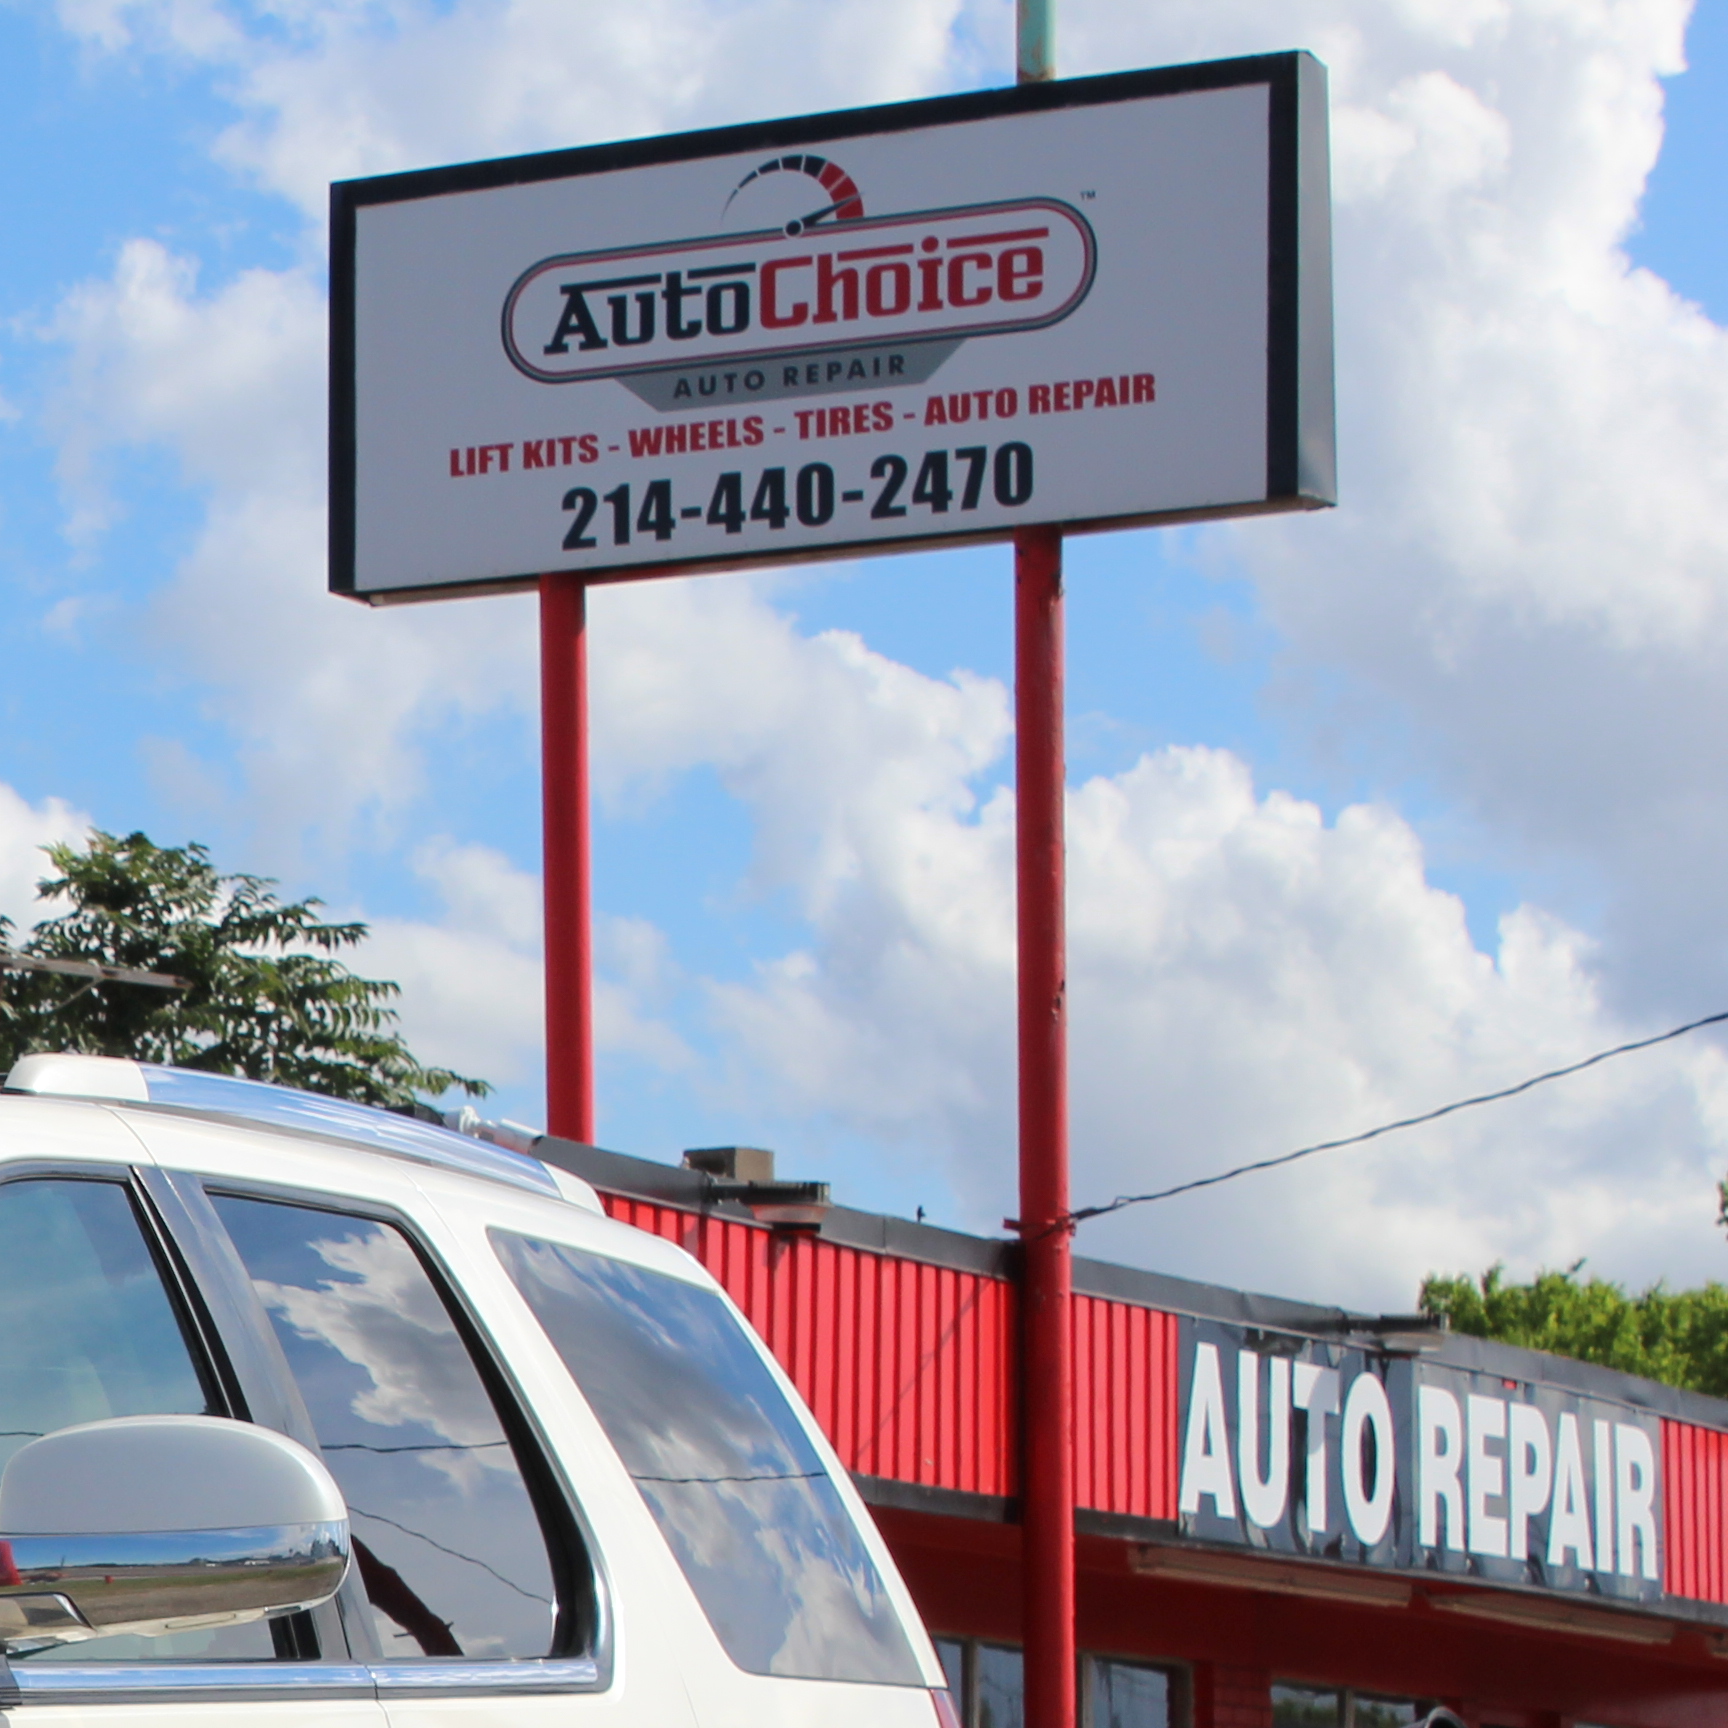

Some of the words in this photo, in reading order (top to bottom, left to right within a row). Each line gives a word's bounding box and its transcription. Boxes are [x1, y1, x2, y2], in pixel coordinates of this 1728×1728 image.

[543, 226, 1050, 355] AutoChoice
[450, 442, 514, 478] LIFT
[523, 433, 600, 469] KITS
[627, 414, 764, 458] WHEELS
[793, 401, 894, 440] TIRES
[924, 386, 1019, 426] AUTO
[1028, 372, 1157, 416] REPAIR
[672, 369, 765, 400] AUTO
[783, 353, 905, 387] REPAIR
[561, 440, 1034, 551] 214-440-2470
[1179, 1341, 1396, 1547] AUTO
[1417, 1384, 1659, 1581] REPAIR
